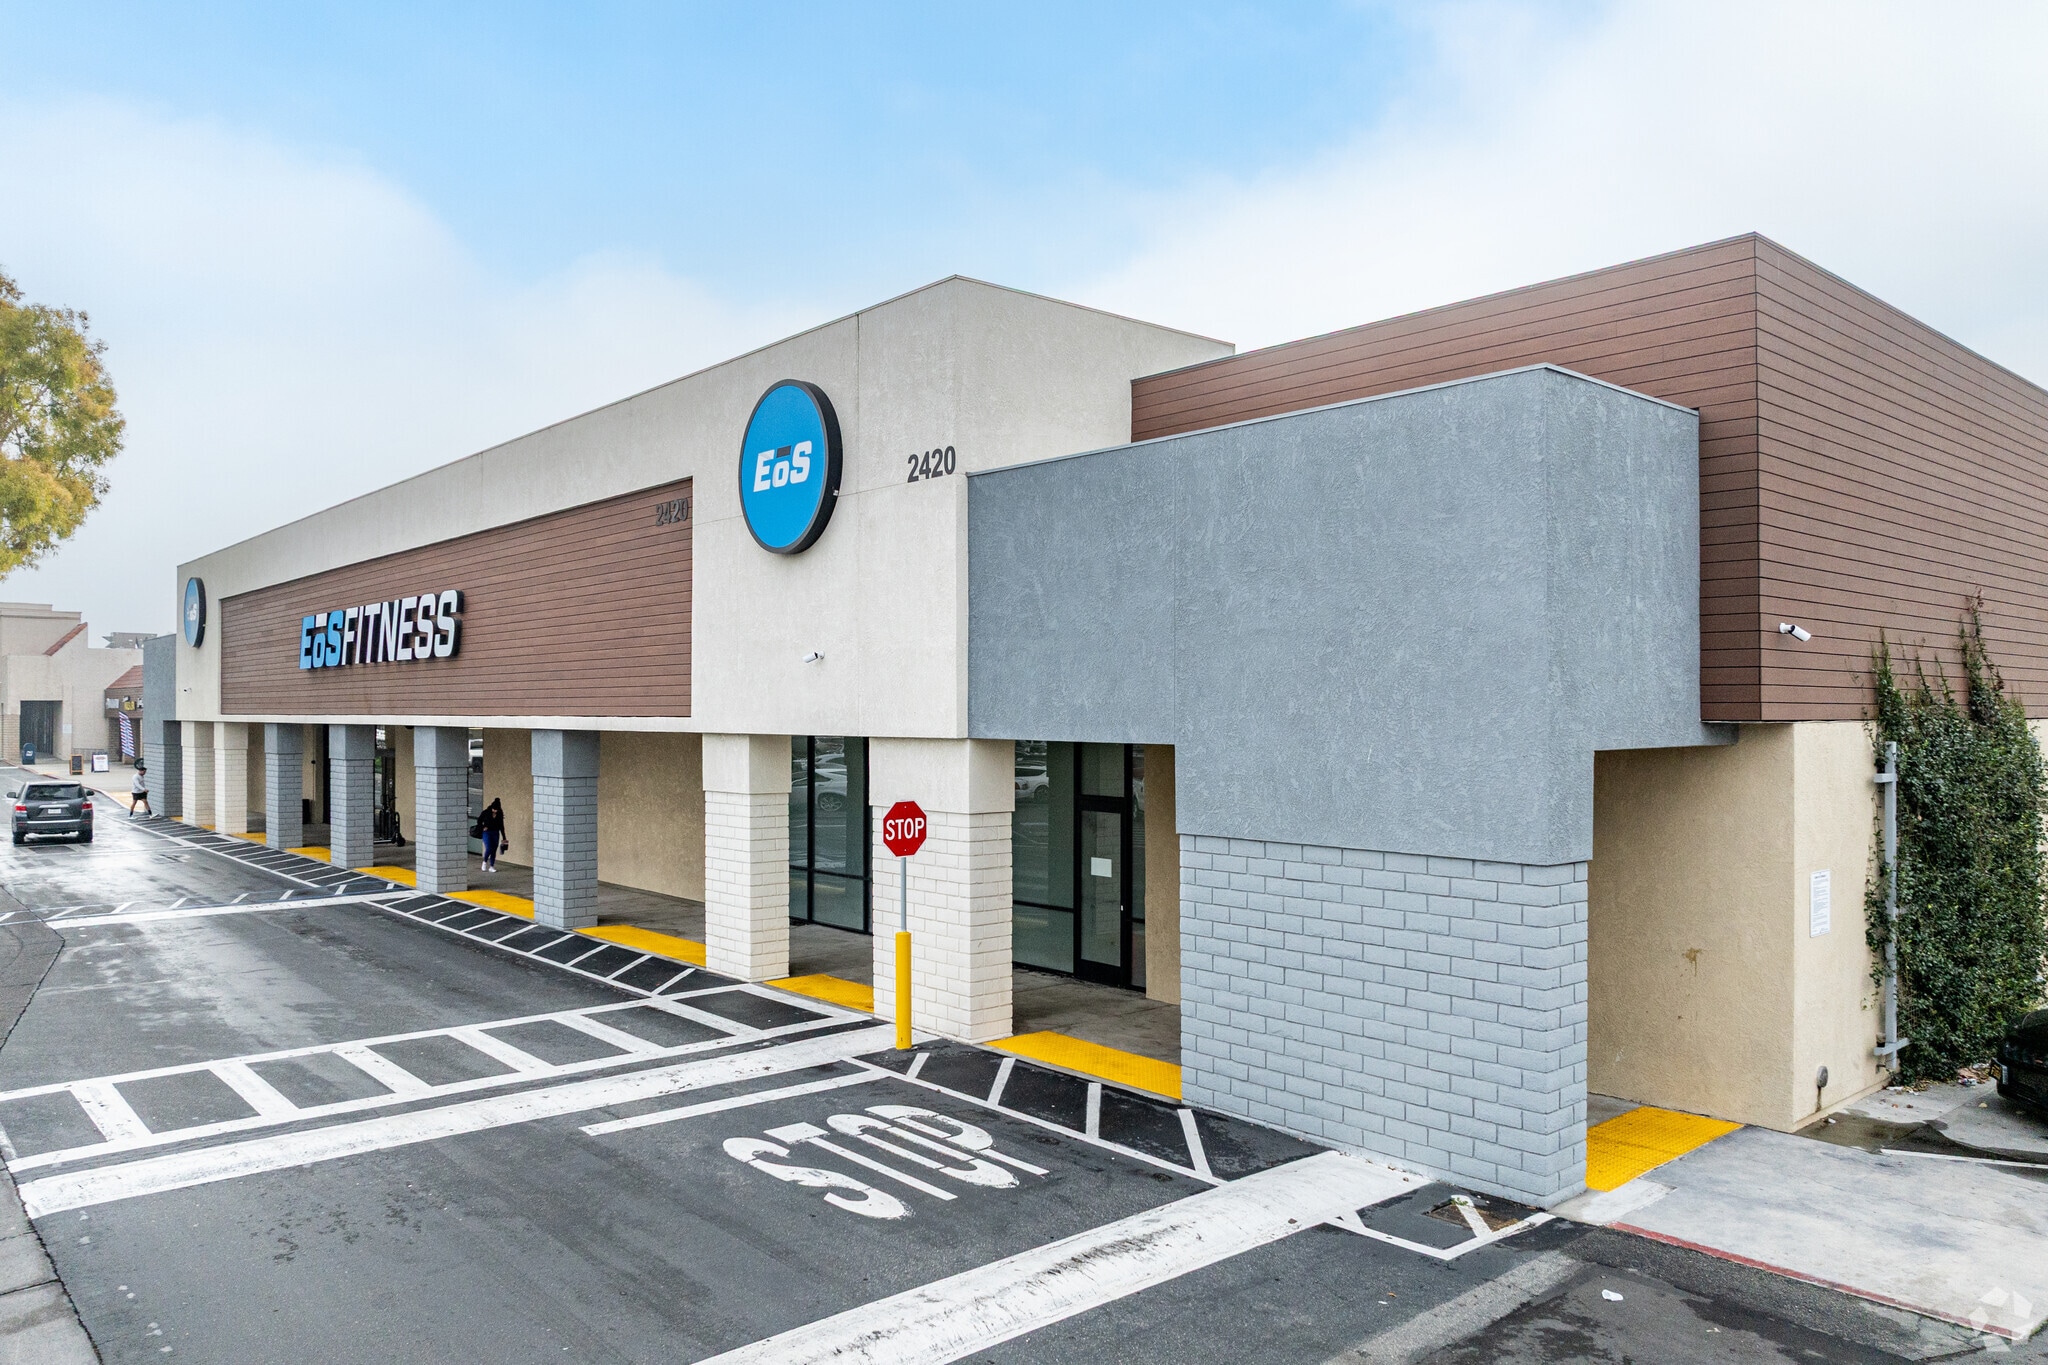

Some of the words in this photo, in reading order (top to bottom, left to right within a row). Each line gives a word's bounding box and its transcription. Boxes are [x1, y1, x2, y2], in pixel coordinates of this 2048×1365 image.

[907, 445, 956, 483] 2420
[655, 498, 689, 526] 2420
[885, 817, 925, 841] STOP
[722, 1104, 1050, 1220] STOP
